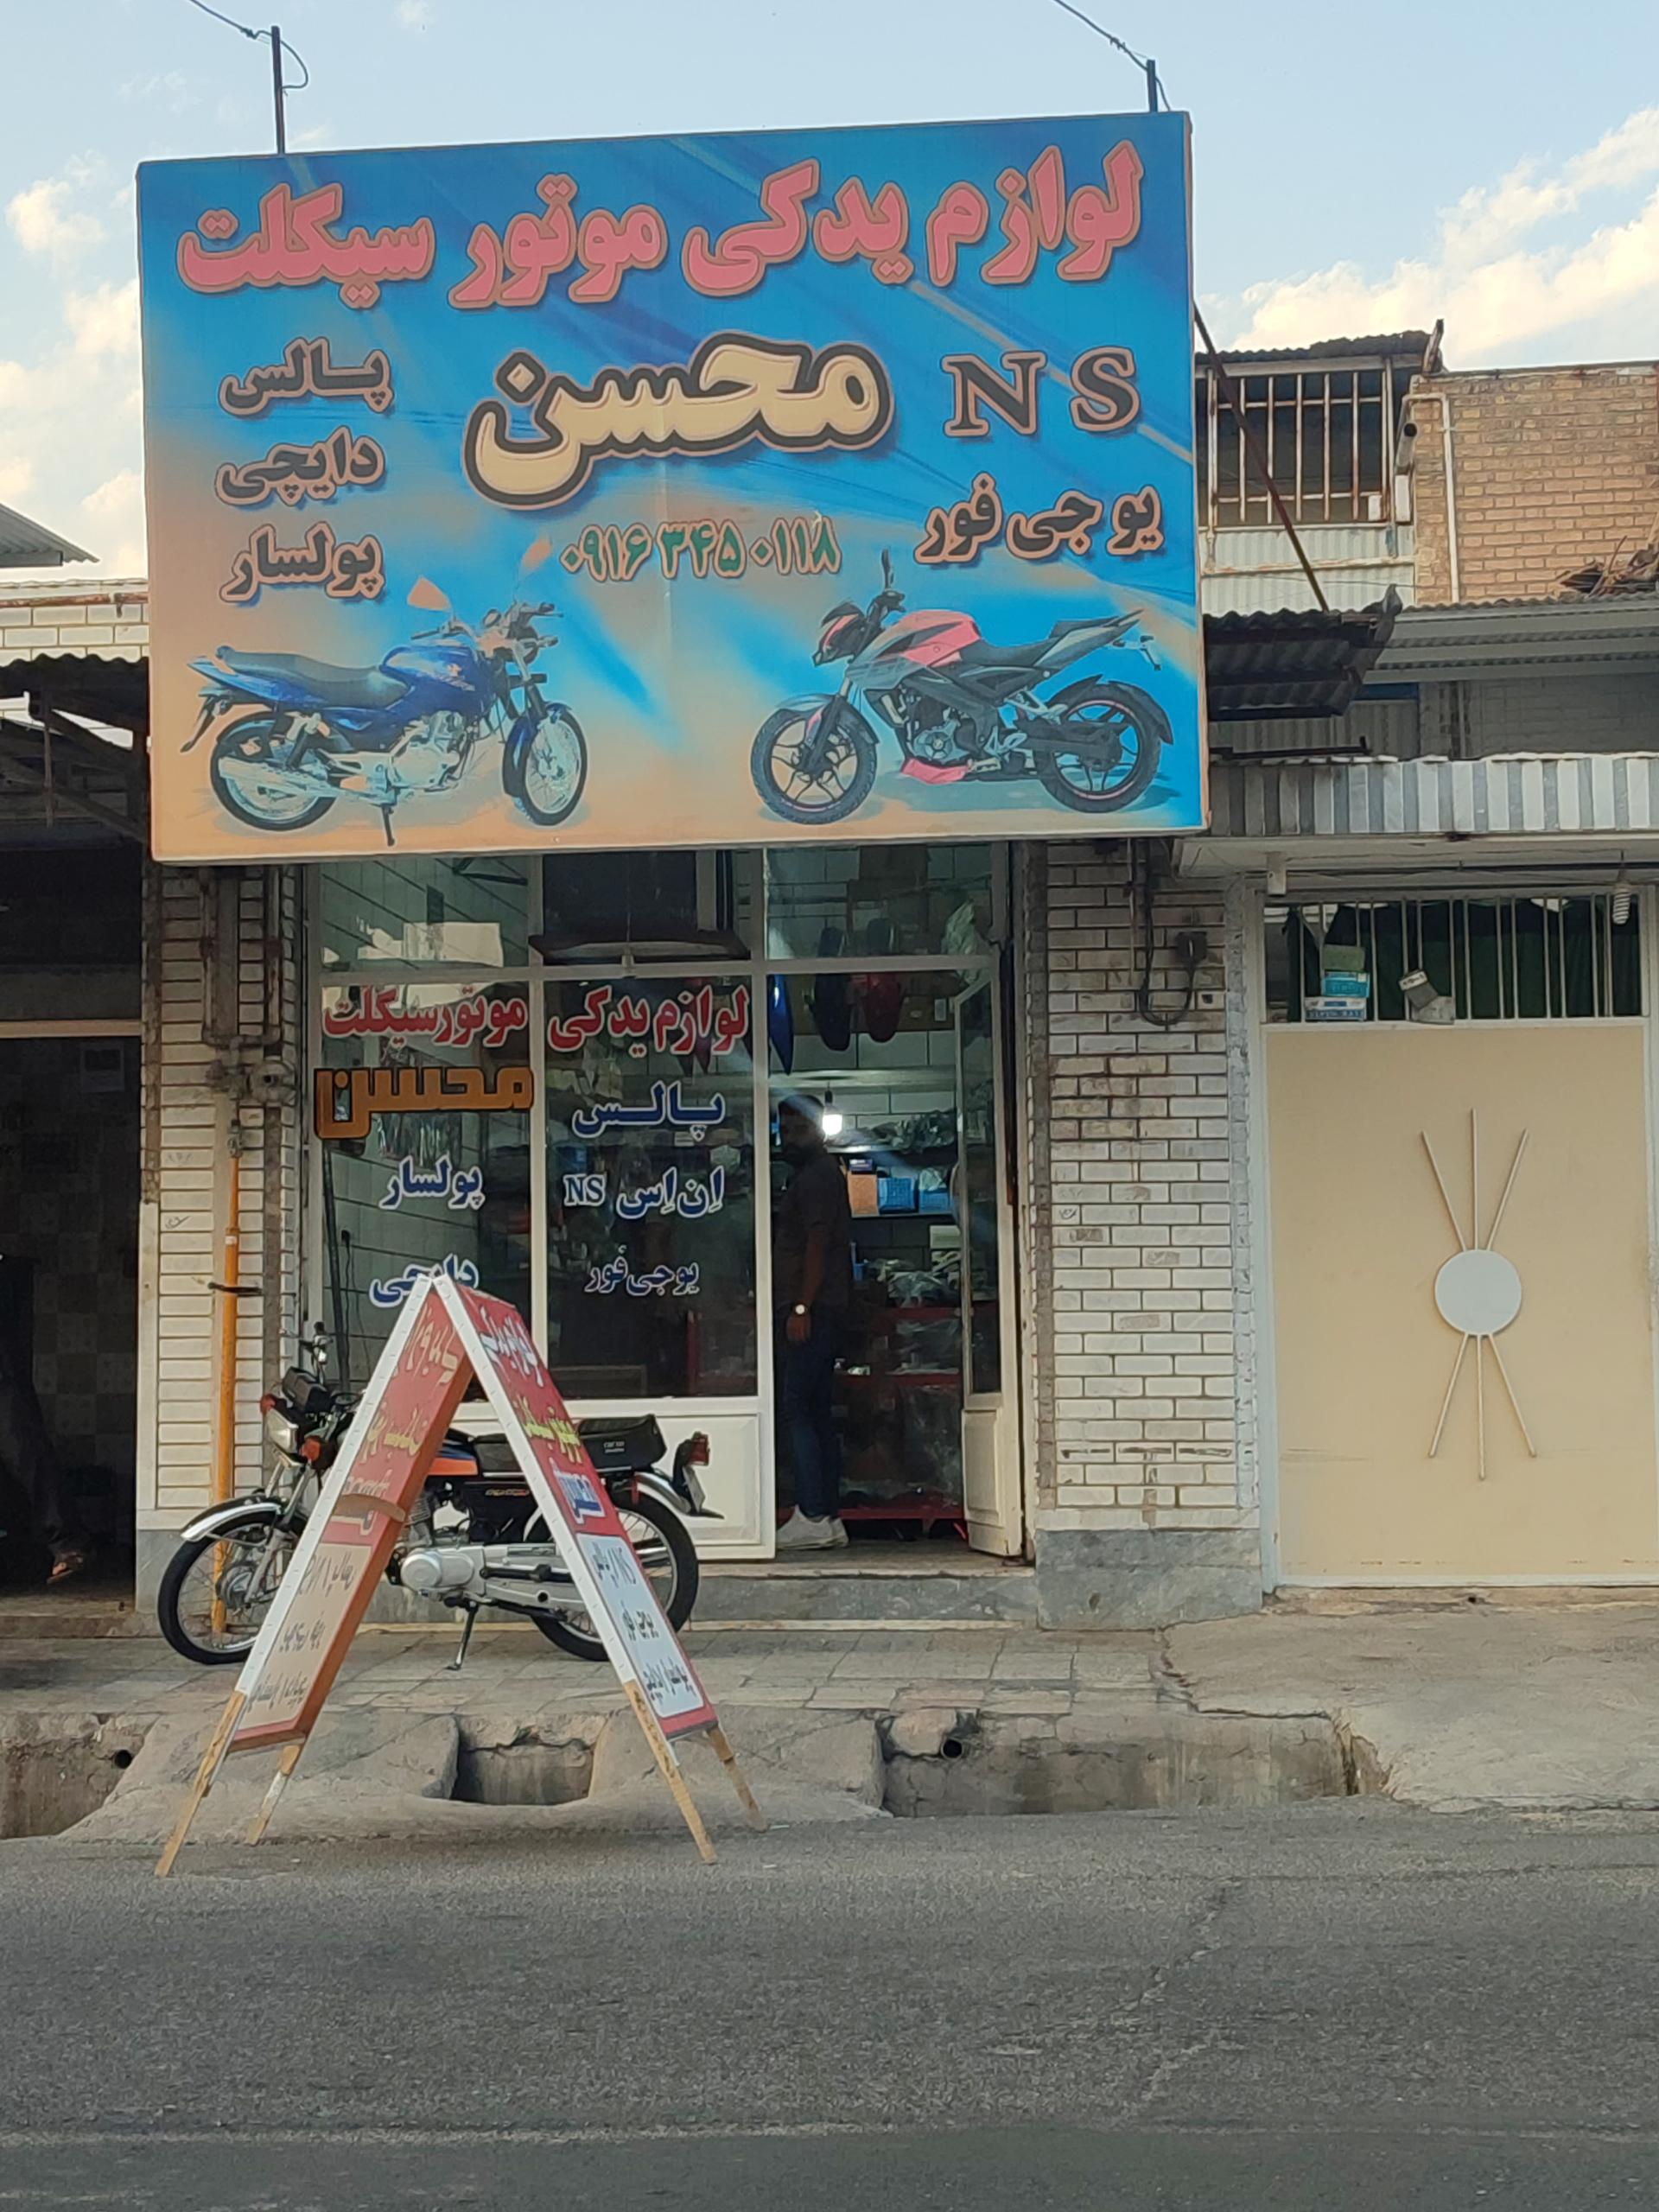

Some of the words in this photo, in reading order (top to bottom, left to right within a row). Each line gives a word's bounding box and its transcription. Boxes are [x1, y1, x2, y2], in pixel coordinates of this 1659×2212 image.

[177, 182, 435, 308] سیکلت
[448, 174, 666, 308] موتور
[682, 157, 914, 296] یدکی
[926, 139, 1144, 288] لوازم
[219, 336, 394, 416] پالس
[463, 330, 894, 510] محسن
[215, 426, 386, 507] دایچی
[219, 521, 385, 604] پولسار
[548, 985, 650, 1058] یدکی
[653, 985, 749, 1055] لوازم
[314, 1066, 534, 1138] محسن
[571, 1081, 725, 1141] پالس
[378, 1154, 486, 1210] پولسار
[563, 1173, 607, 1206] NS
